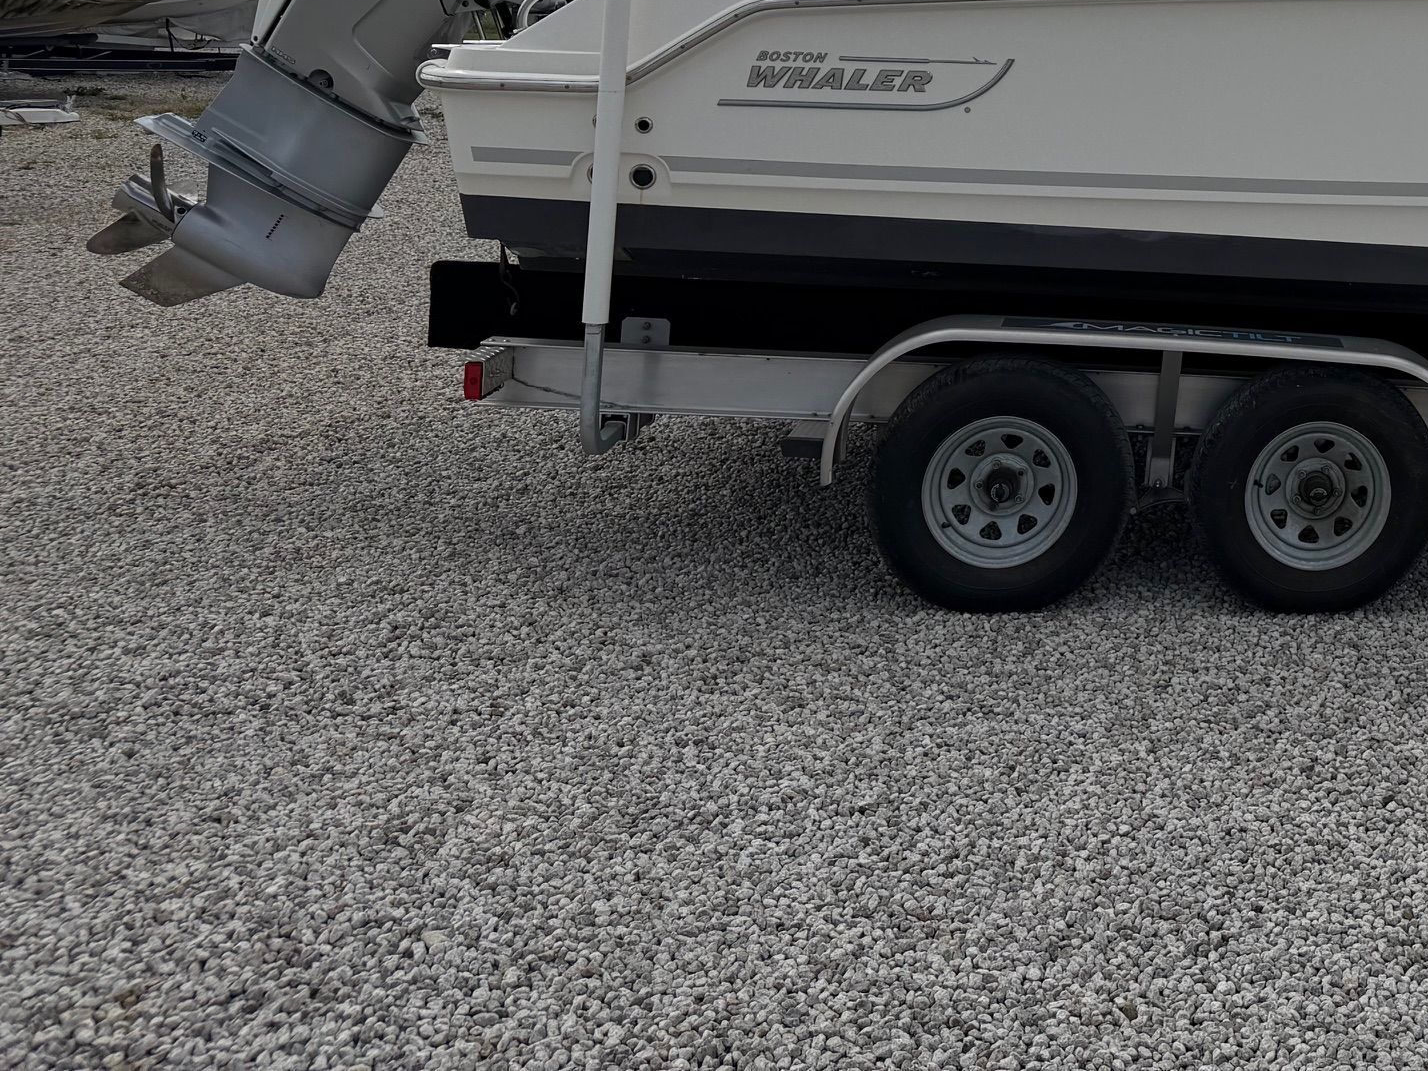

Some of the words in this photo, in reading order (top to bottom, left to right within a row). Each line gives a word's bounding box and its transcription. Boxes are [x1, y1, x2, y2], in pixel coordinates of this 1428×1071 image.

[756, 50, 829, 64] BOSTON
[746, 65, 934, 93] WHALER
[1080, 322, 1302, 343] MAGICTILT
